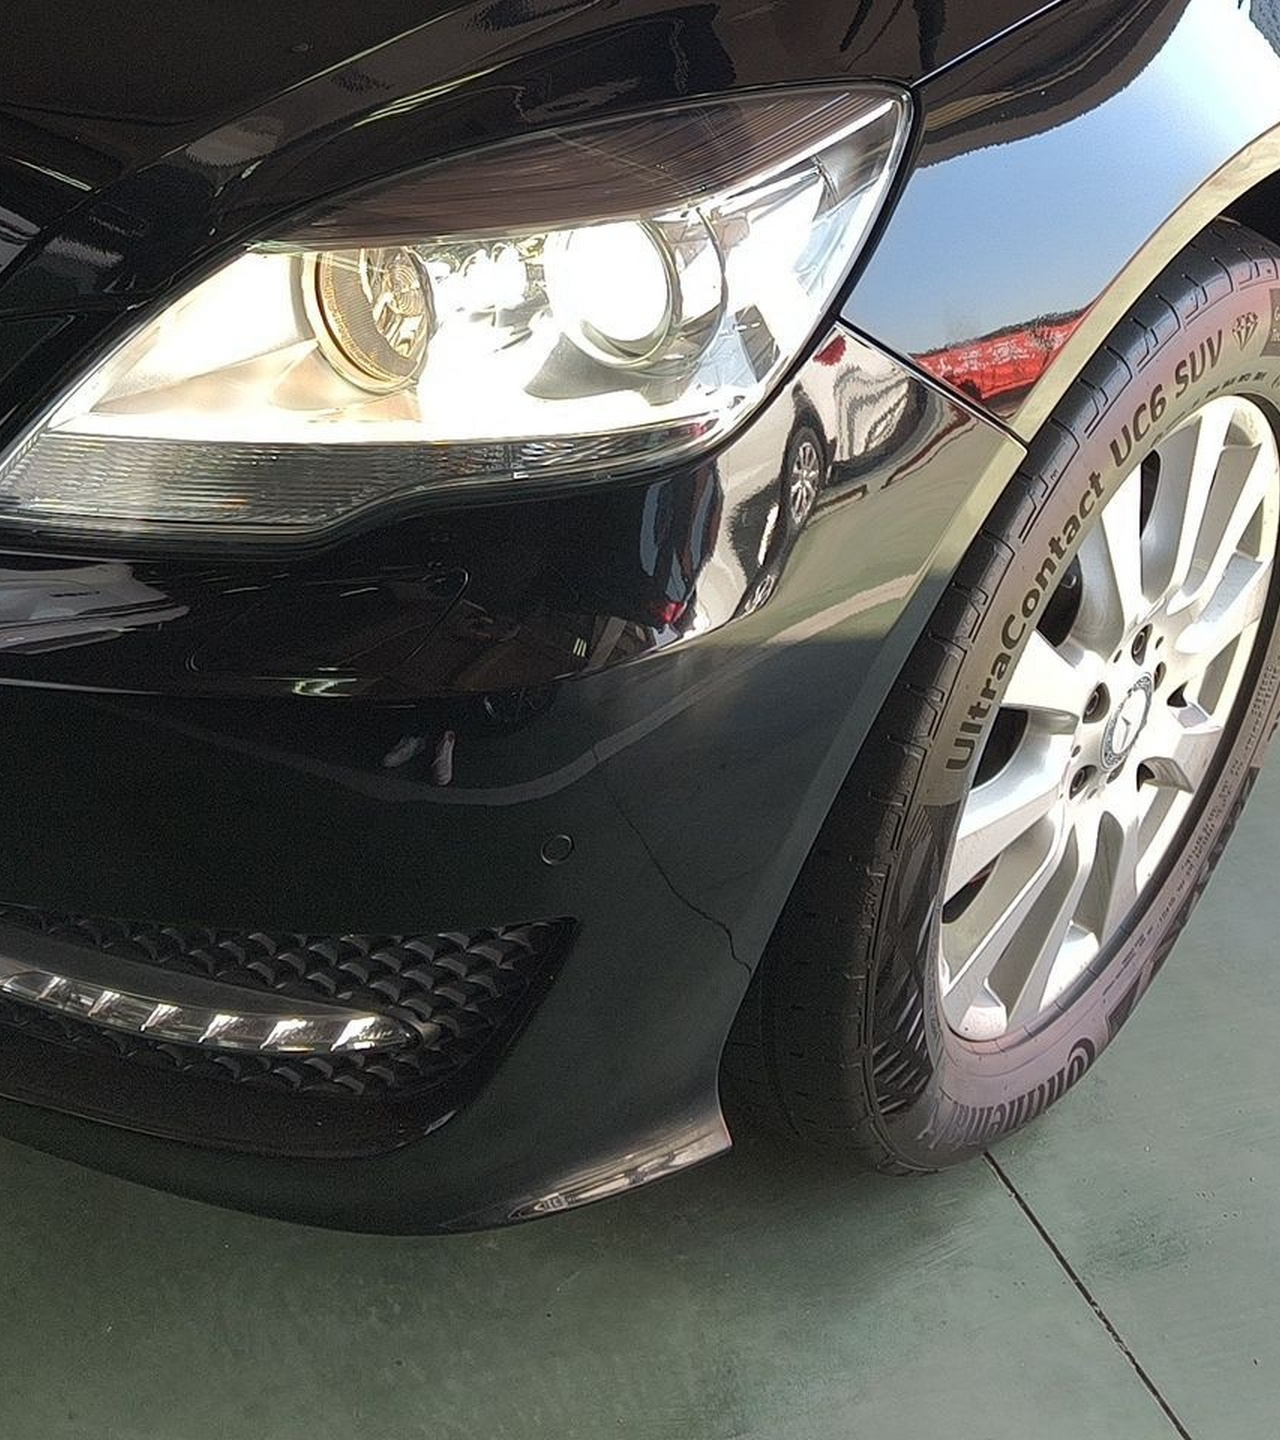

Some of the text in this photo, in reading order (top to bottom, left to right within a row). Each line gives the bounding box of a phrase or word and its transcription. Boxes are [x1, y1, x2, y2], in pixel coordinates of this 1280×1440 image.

[946, 329, 1222, 770] UltraContact UC6 SUV
